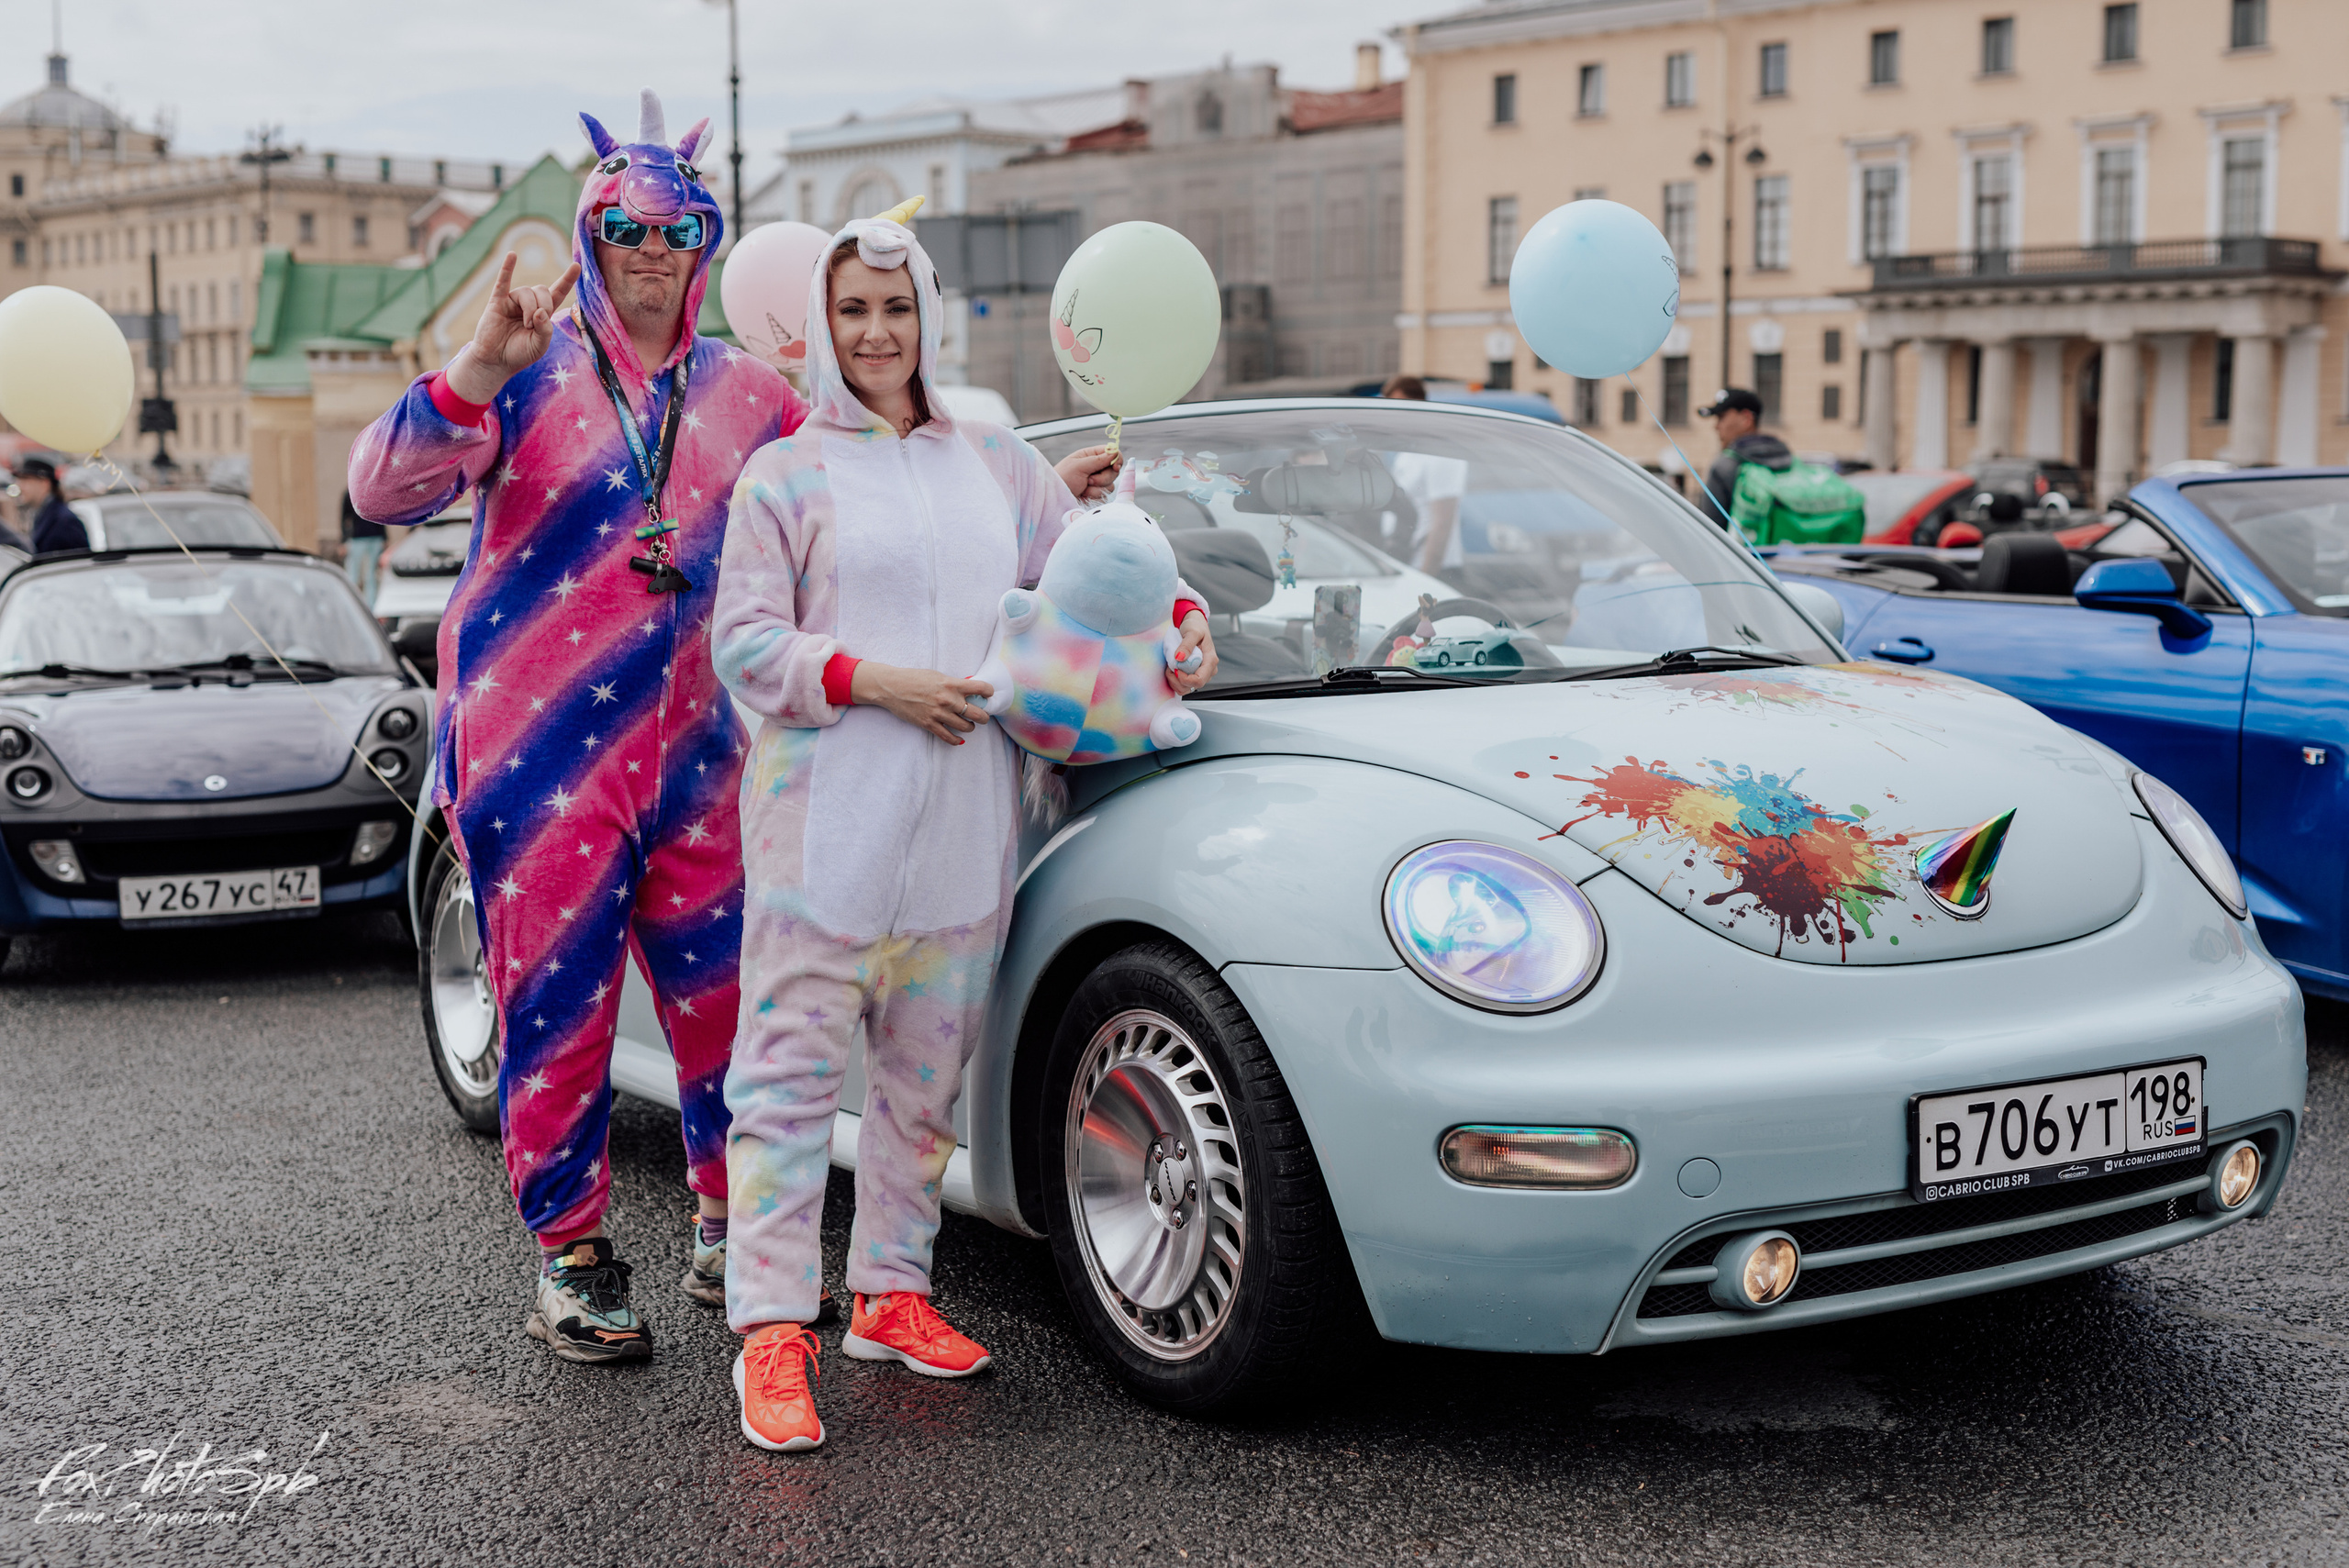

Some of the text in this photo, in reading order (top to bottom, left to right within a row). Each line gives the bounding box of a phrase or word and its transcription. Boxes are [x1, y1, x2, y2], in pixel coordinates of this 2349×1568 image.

[632, 444, 649, 479] ДЕТАЛЯХ
[277, 871, 307, 895] 47
[2129, 1071, 2191, 1123] 198
[2143, 1121, 2174, 1140] RUS
[2113, 1144, 2201, 1169] VK.COM/CABRIOCLUBSPB
[1938, 1173, 2031, 1198] CABRIO CLUB SPB
